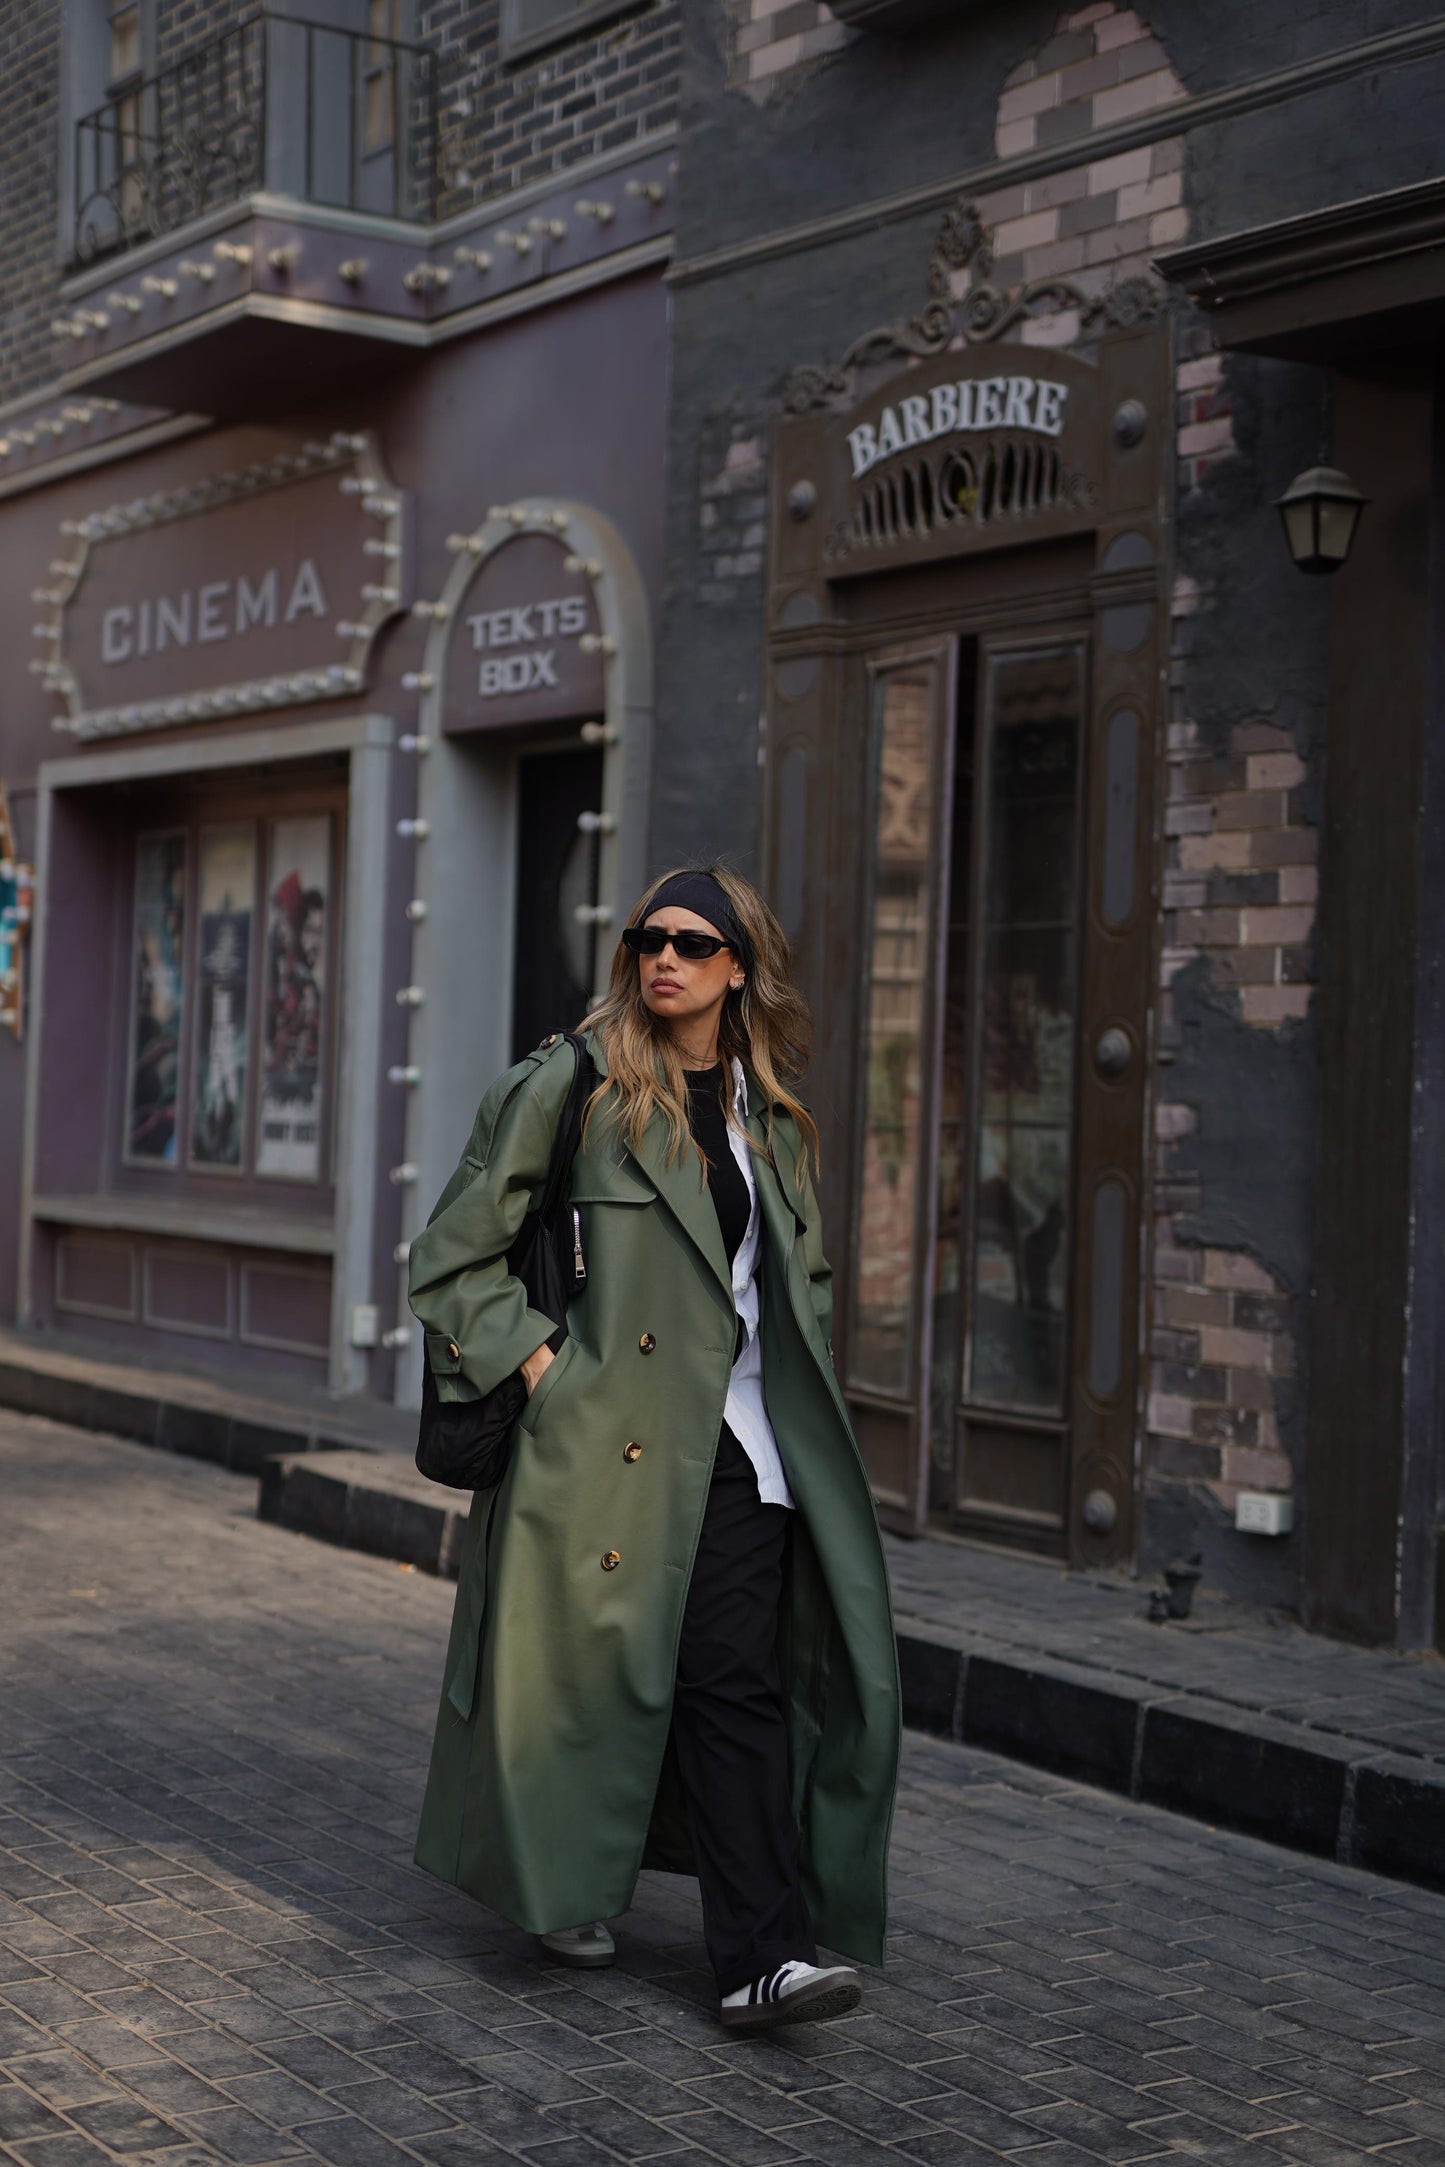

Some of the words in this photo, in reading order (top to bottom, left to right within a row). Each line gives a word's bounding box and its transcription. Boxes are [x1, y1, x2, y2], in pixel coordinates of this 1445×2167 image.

[847, 376, 1069, 478] BARBIERE
[102, 559, 327, 664] CINEMA
[467, 596, 588, 648] TEKTS
[478, 650, 558, 696] BOX
